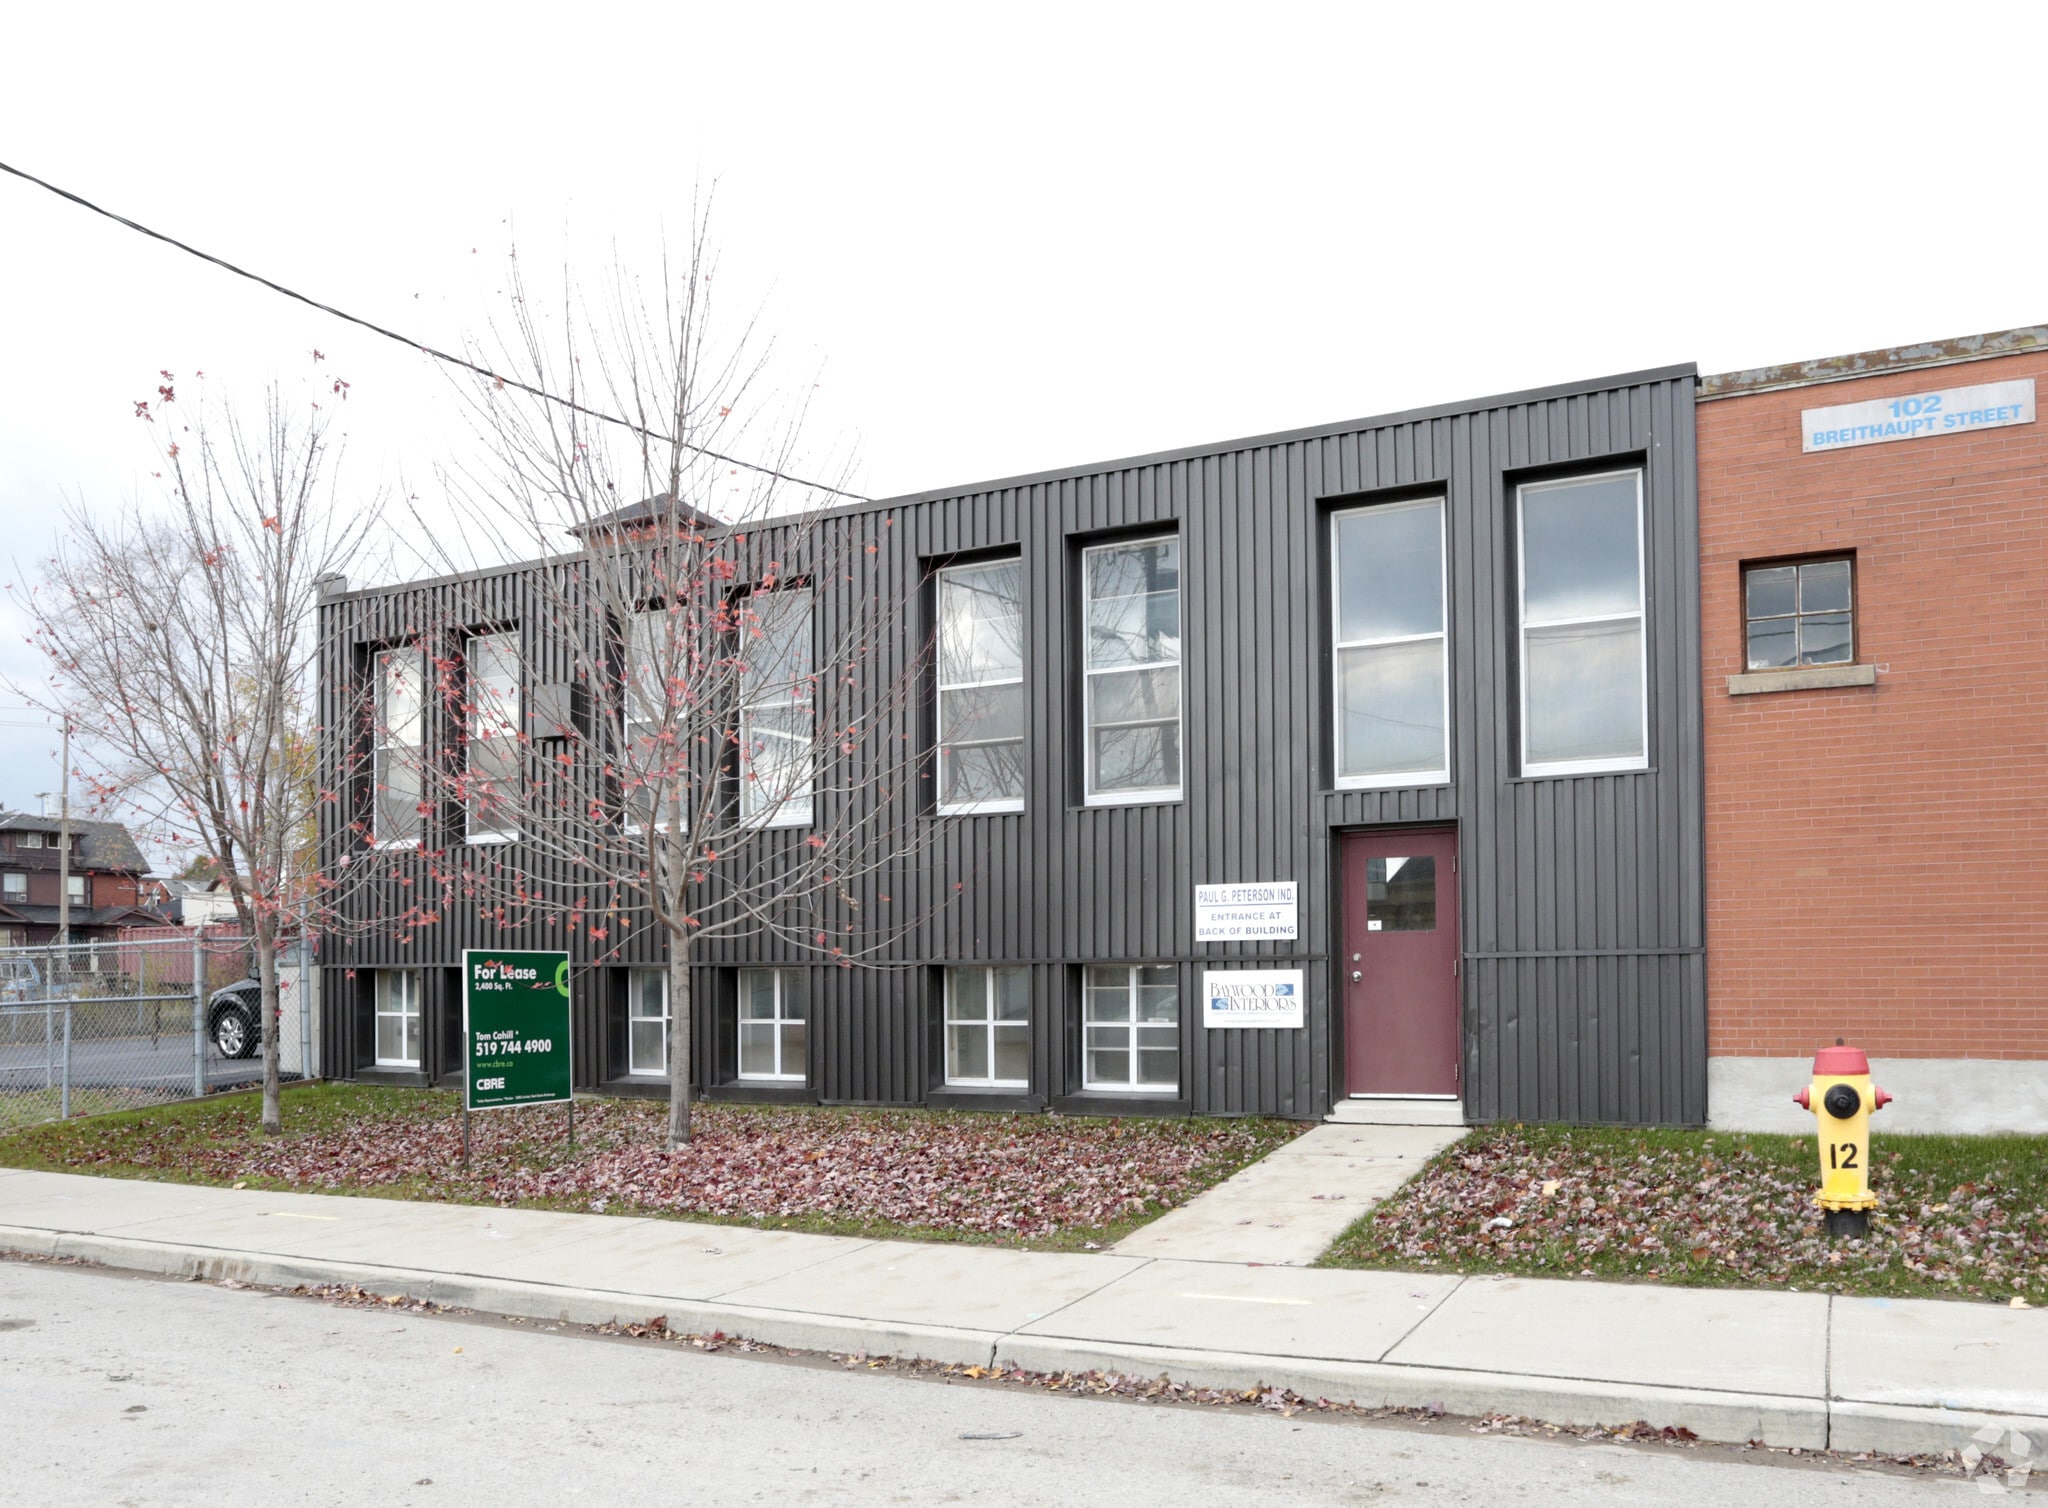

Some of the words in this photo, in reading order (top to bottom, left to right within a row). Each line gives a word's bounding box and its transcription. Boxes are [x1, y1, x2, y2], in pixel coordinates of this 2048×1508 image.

[1889, 395, 1943, 418] 102
[1813, 417, 1936, 446] BREITHAUPT
[1944, 404, 2023, 429] STREET
[1199, 890, 1218, 903] PAUL
[1221, 890, 1230, 903] G.
[1231, 888, 1275, 902] PETERSON
[1277, 888, 1294, 901] IND.
[1211, 912, 1265, 921] ENTRANCE
[1269, 911, 1281, 920] AT
[1199, 927, 1225, 936] BACK
[1229, 927, 1242, 935] OF
[1245, 926, 1295, 935] BUILDING
[474, 964, 497, 980] For
[475, 1032, 491, 1040] Tom
[475, 1041, 498, 1057] 519
[500, 1040, 522, 1055] 744
[524, 1038, 552, 1053] 4900
[476, 1077, 505, 1091] CBRE
[1830, 1143, 1858, 1169] 12
